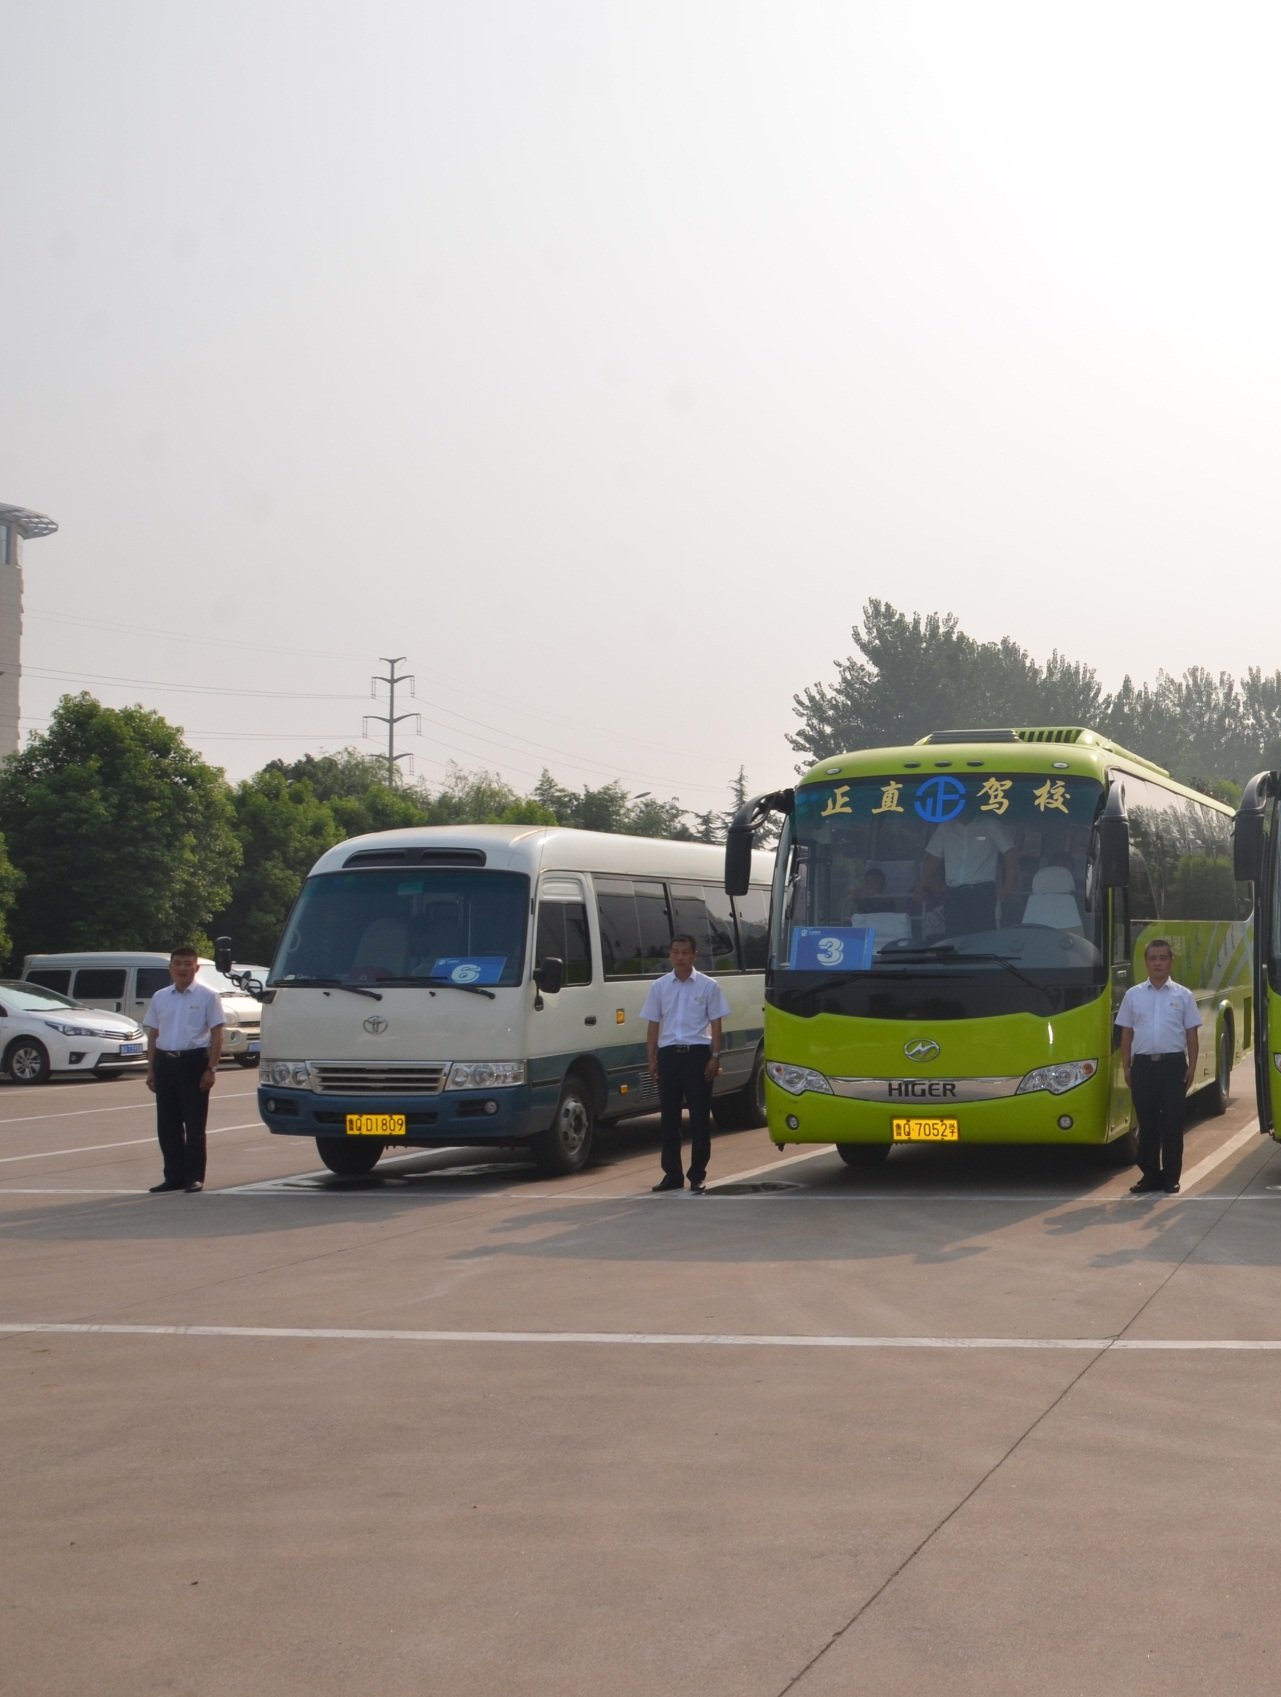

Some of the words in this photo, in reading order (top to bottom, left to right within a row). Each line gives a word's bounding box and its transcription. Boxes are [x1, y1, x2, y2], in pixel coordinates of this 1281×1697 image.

[821, 780, 904, 817] 正直
[976, 777, 1071, 815] 驾校
[817, 937, 845, 966] 3
[888, 1082, 957, 1097] HIGER
